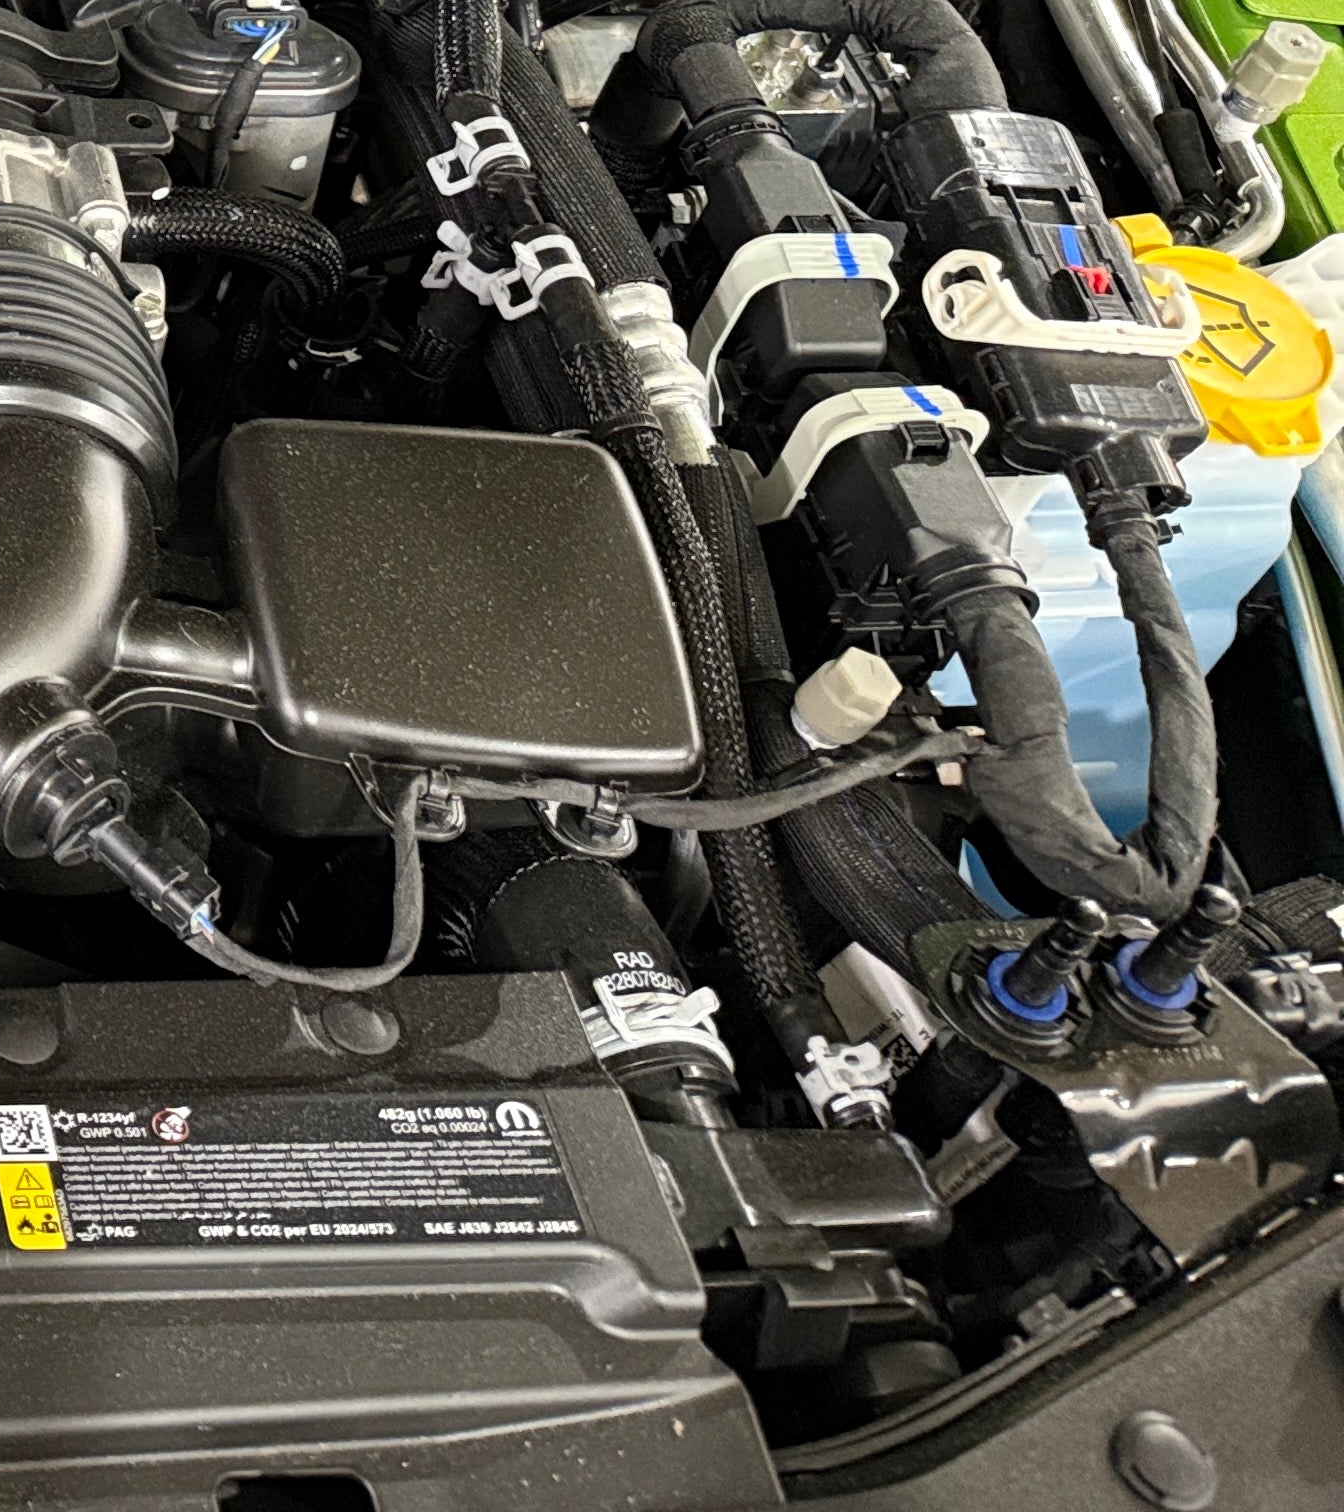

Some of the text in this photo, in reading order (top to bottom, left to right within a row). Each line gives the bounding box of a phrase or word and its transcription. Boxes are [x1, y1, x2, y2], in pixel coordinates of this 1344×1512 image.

[613, 951, 654, 970] RAD
[76, 1111, 136, 1126] R-1234yf
[378, 1107, 416, 1123] 482g
[465, 1106, 488, 1122] lb)
[80, 1126, 148, 1139] GWP 0.501
[390, 1123, 420, 1135] CO2
[421, 1124, 439, 1137] eq
[104, 1225, 137, 1238] PAG
[198, 1224, 234, 1238] GWP
[236, 1224, 249, 1237] &
[250, 1224, 282, 1237] CO2
[283, 1225, 307, 1239] per
[309, 1223, 330, 1236] EU
[423, 1221, 456, 1235] SAE
